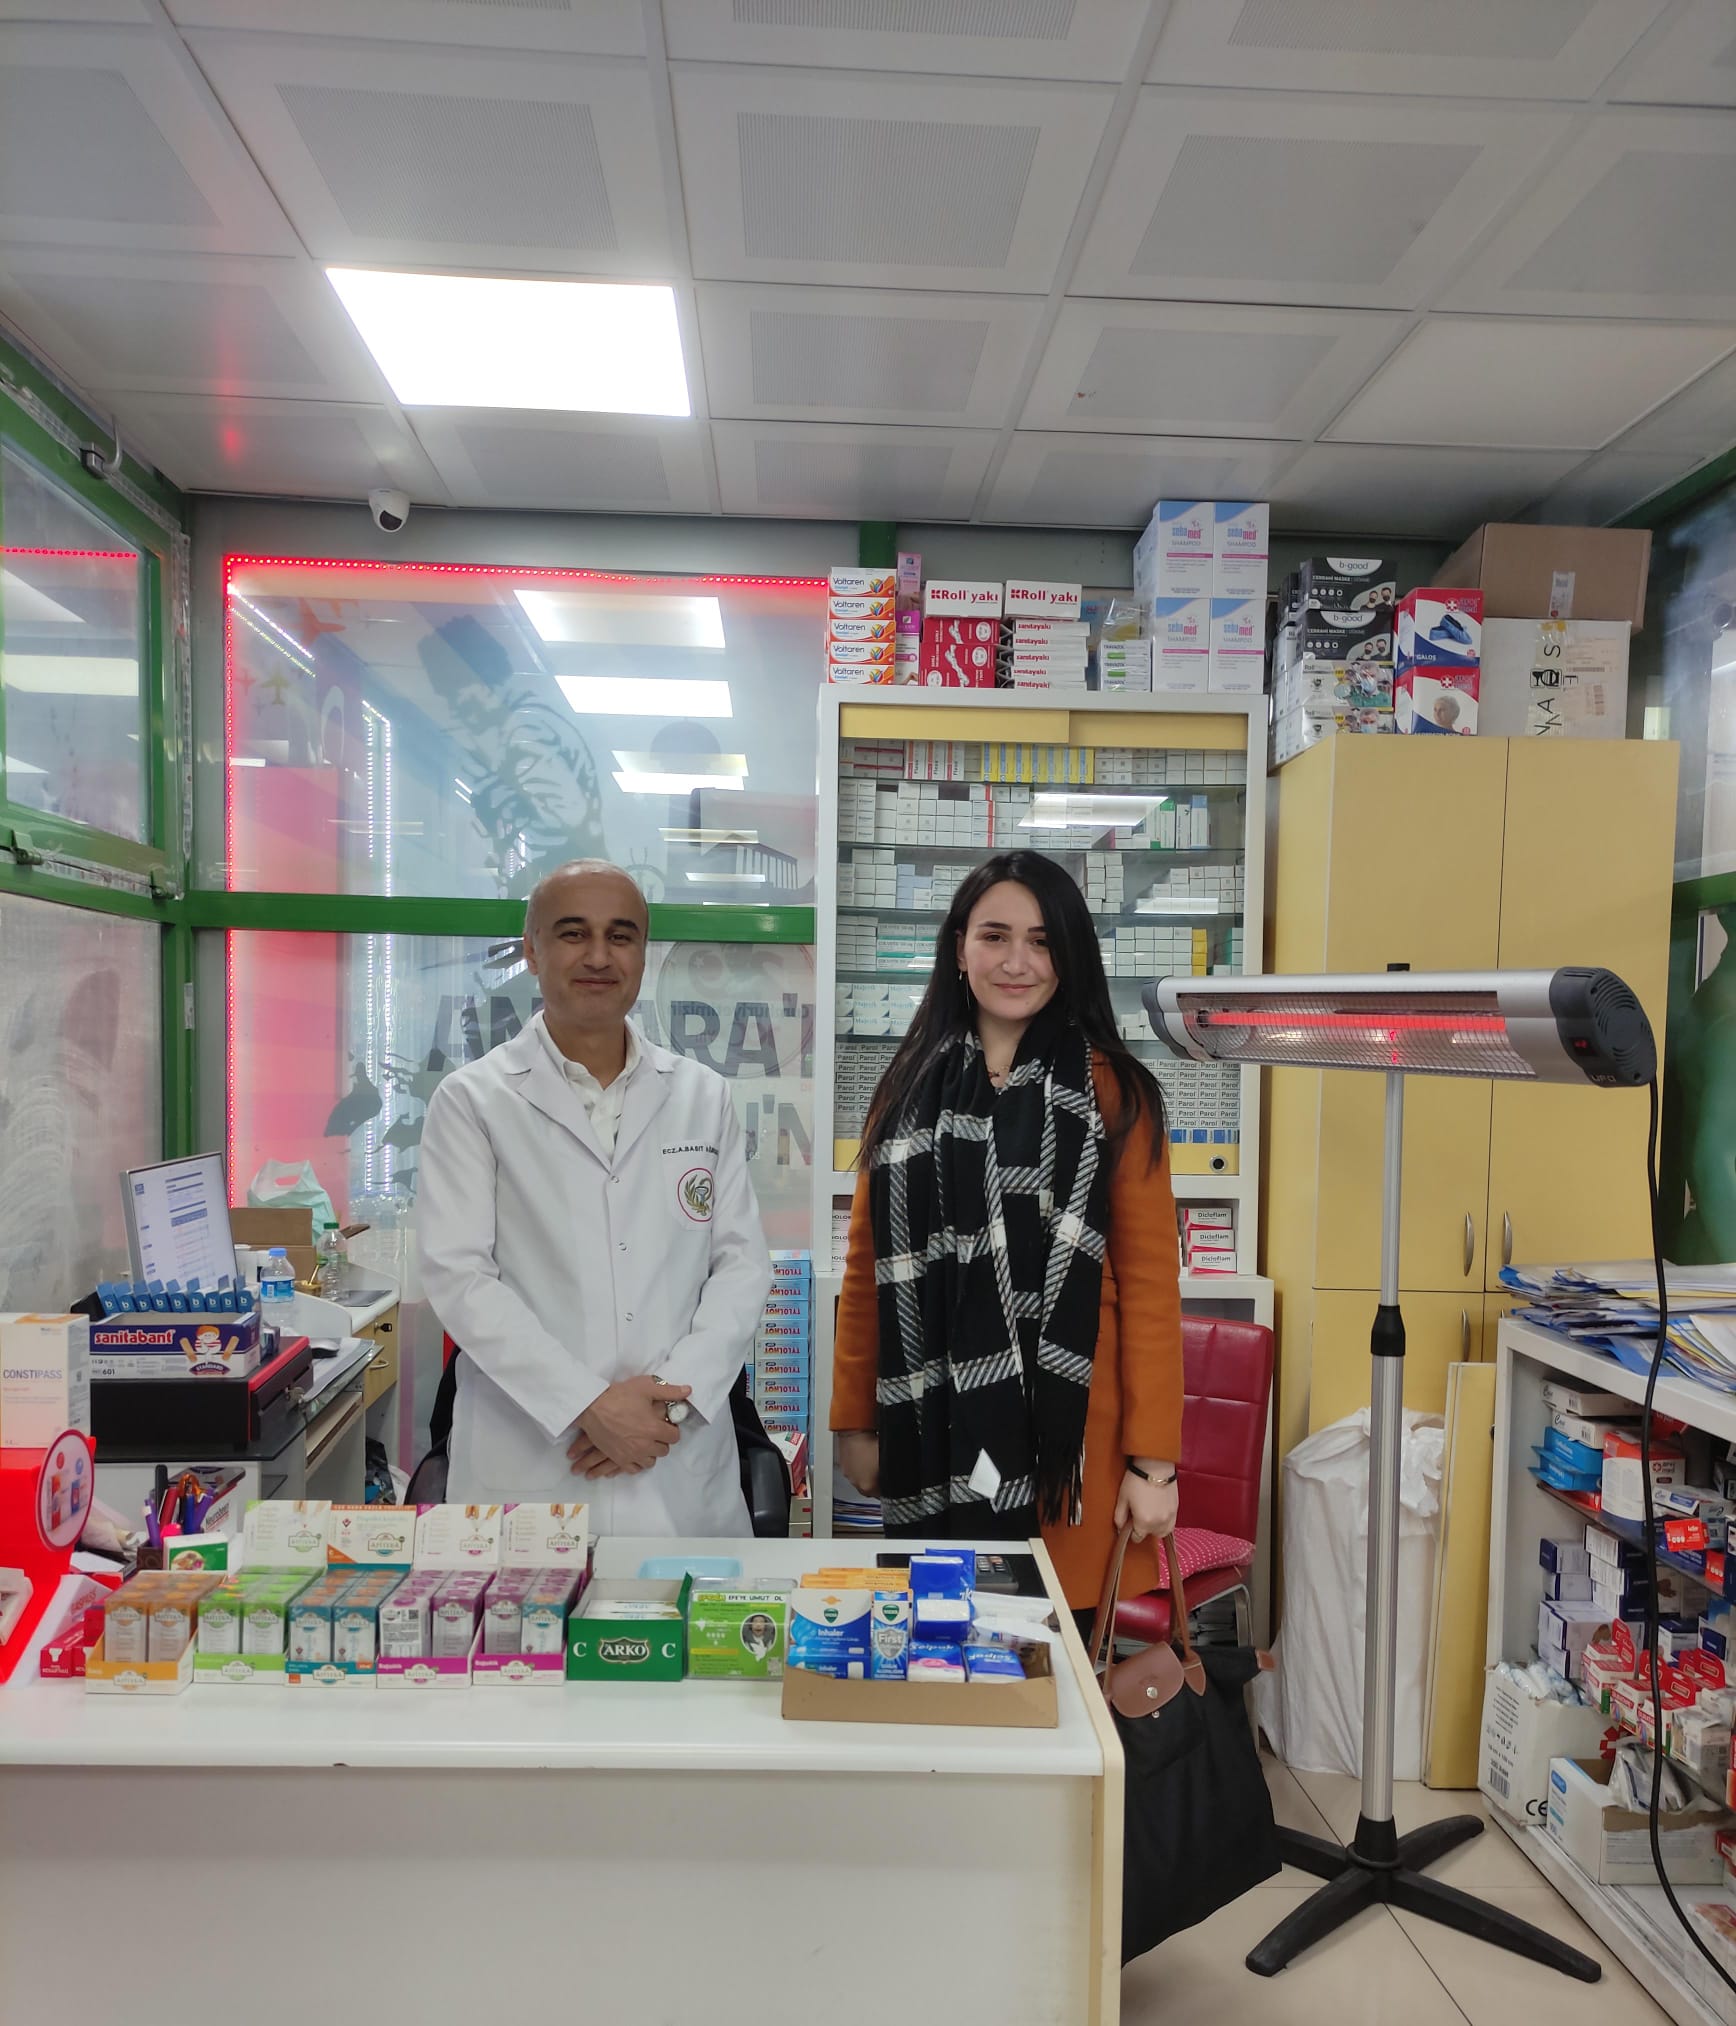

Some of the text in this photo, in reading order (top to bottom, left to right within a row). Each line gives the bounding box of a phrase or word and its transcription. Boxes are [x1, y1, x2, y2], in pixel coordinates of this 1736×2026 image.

[1339, 562, 1369, 570] b-good
[833, 577, 865, 586] Voltaren
[833, 600, 865, 609] Voltaren
[1333, 614, 1363, 623] b-good
[834, 623, 866, 631] Voltaren
[833, 645, 865, 653] Voltaren
[833, 667, 864, 676] Voltaren
[769, 1288, 801, 1296] TYLOLHO
[765, 1327, 801, 1335] TYLOLHOT
[94, 1329, 172, 1344] sanitabant
[3, 1369, 63, 1380] CONSTIPASS
[764, 1385, 800, 1393] TYLOLHOT
[818, 1628, 844, 1636] Inhaler
[879, 1632, 902, 1643] First
[573, 1642, 587, 1657] C
[603, 1644, 646, 1656] ARKO
[661, 1642, 676, 1658] C
